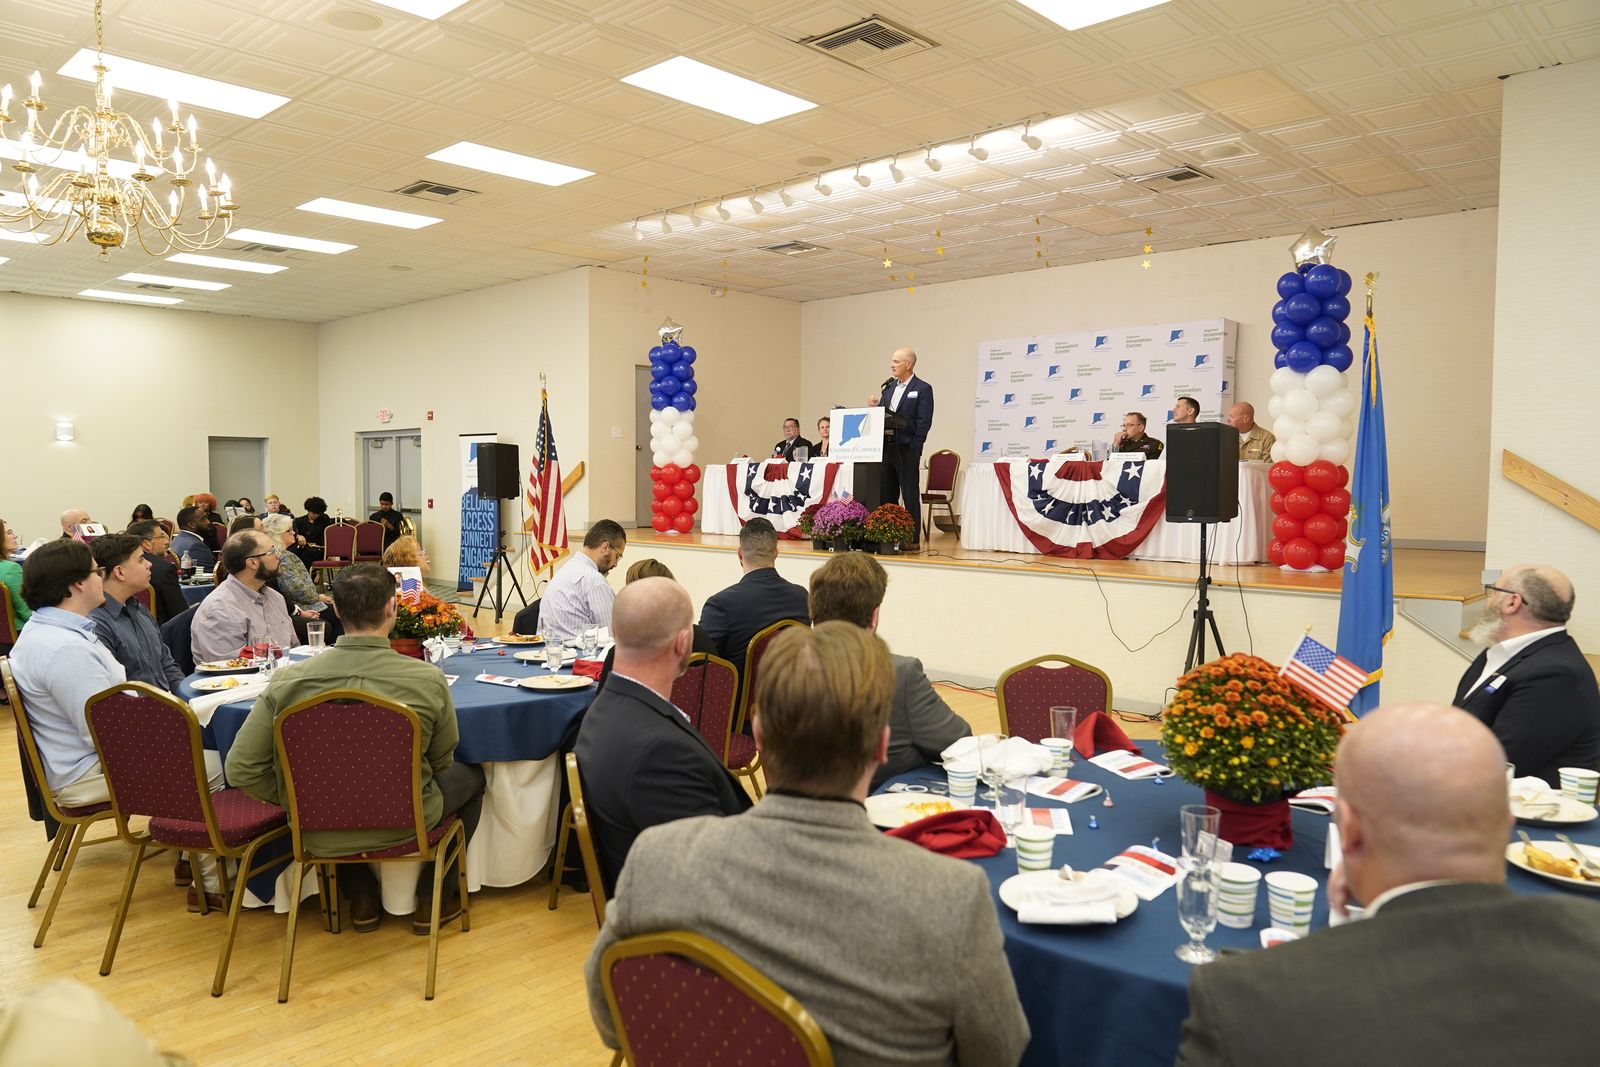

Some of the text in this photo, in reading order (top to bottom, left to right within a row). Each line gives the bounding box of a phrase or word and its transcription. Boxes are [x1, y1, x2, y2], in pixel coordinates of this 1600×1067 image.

[462, 494, 494, 511] BELONG
[462, 512, 494, 531] ACCESS
[461, 531, 494, 547] CONNECT
[461, 547, 494, 567] ENGAGE
